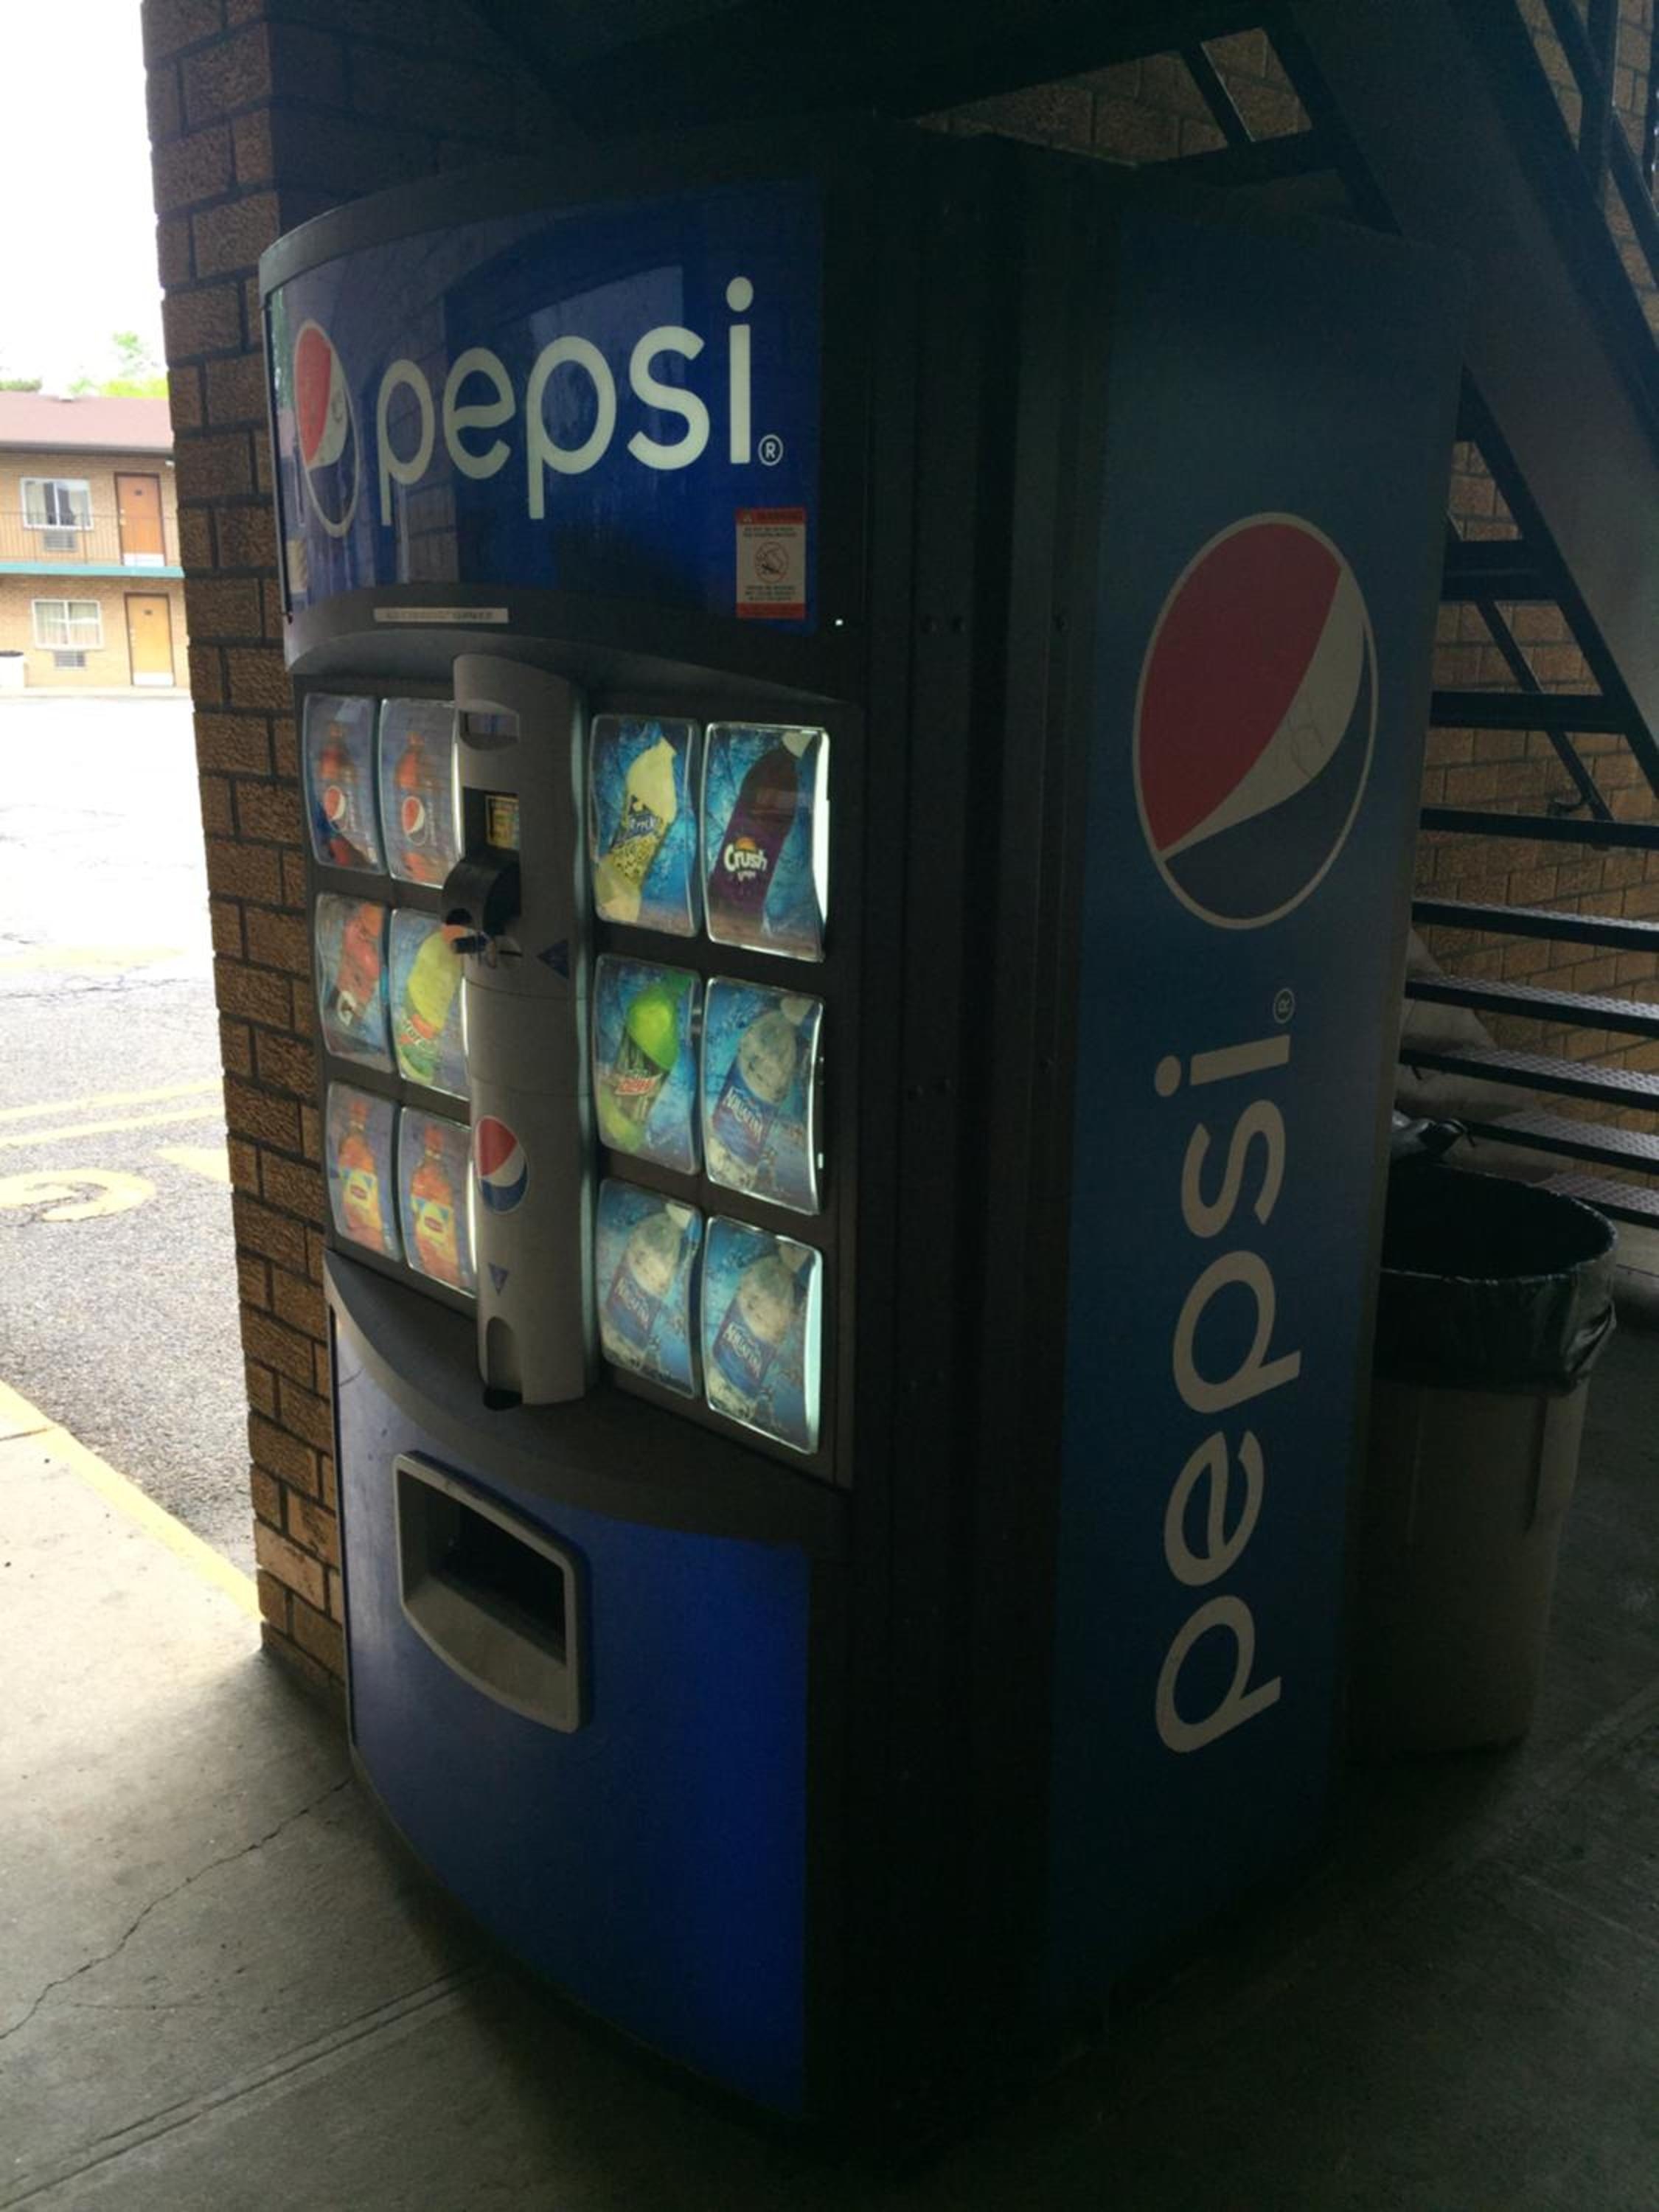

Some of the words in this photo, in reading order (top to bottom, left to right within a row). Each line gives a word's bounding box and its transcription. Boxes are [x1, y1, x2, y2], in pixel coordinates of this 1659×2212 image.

[377, 276, 754, 526] pepsi
[723, 843, 768, 872] Crush
[1155, 1034, 1301, 1753] pepsi
